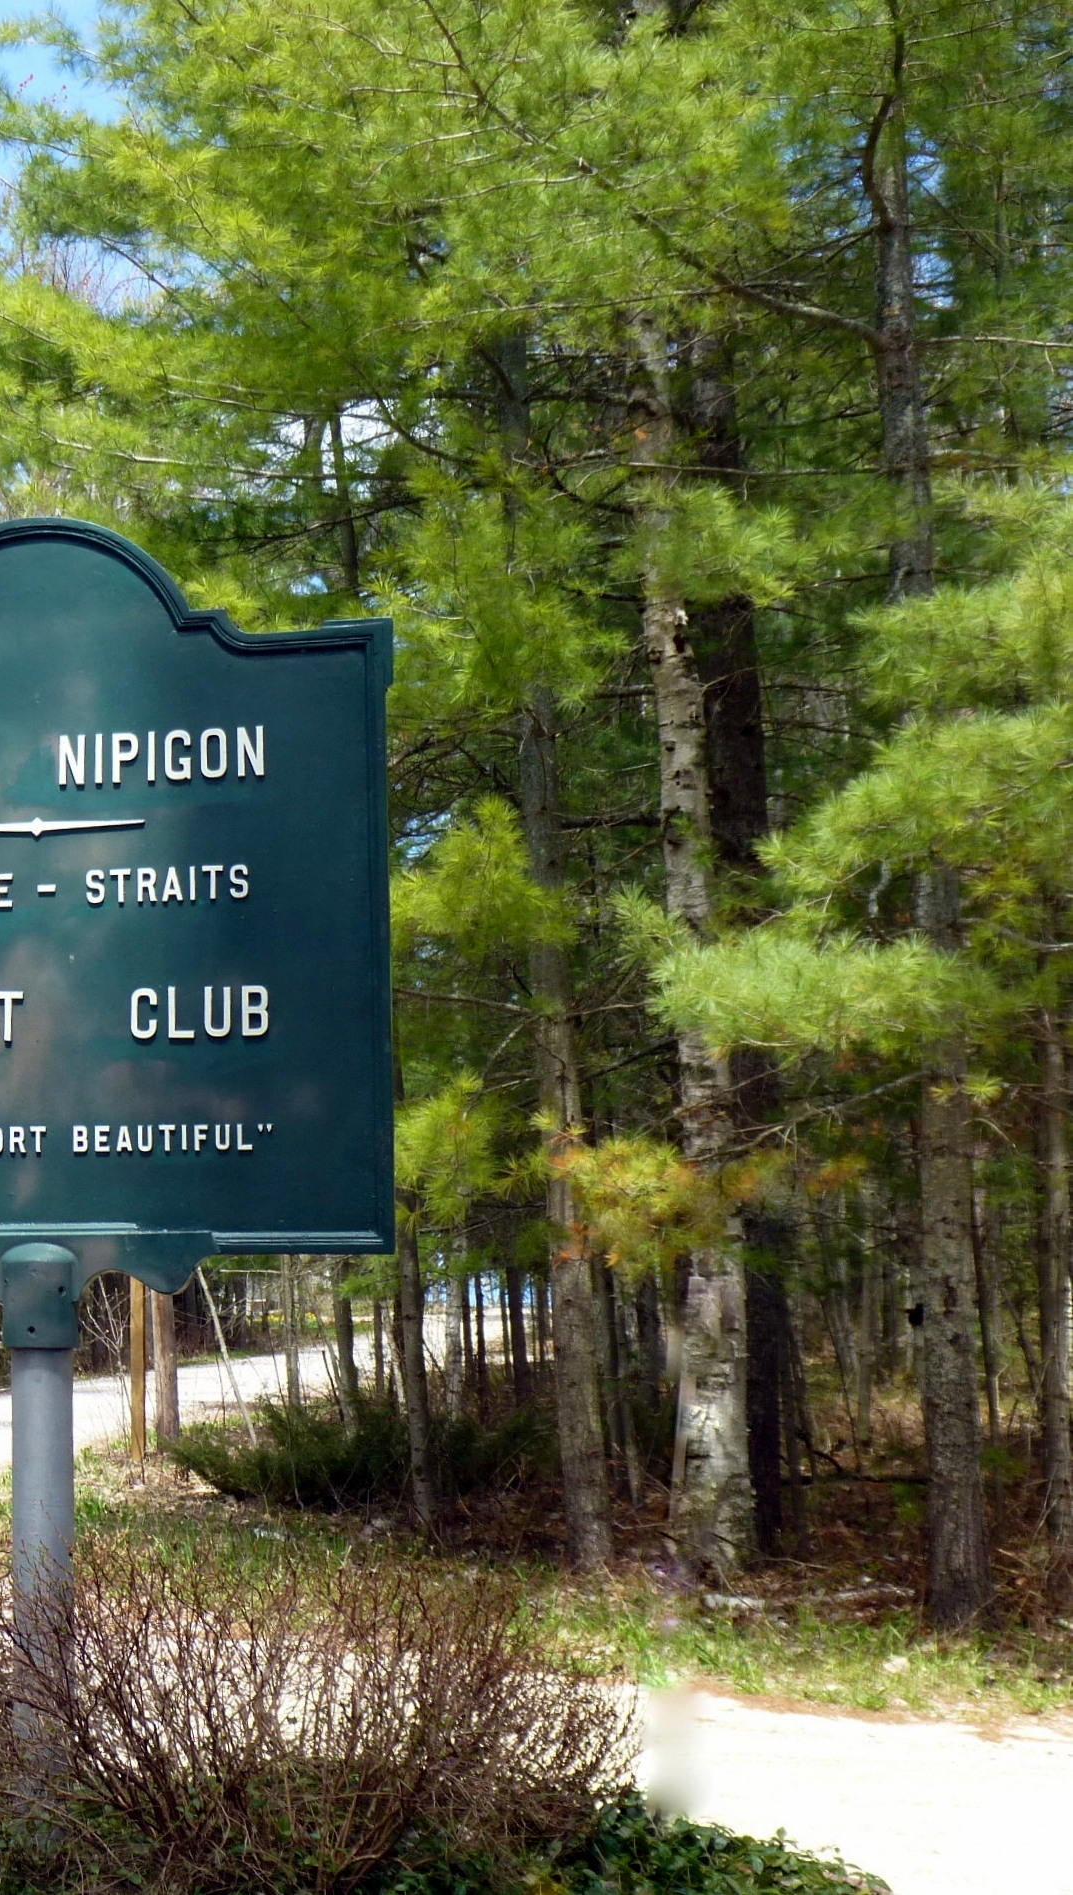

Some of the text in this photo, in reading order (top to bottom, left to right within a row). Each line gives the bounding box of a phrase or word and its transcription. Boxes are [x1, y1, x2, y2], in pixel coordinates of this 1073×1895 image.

[57, 725, 266, 787] NIPIGON
[85, 864, 251, 905] STRAITS
[130, 985, 271, 1040] CLUB
